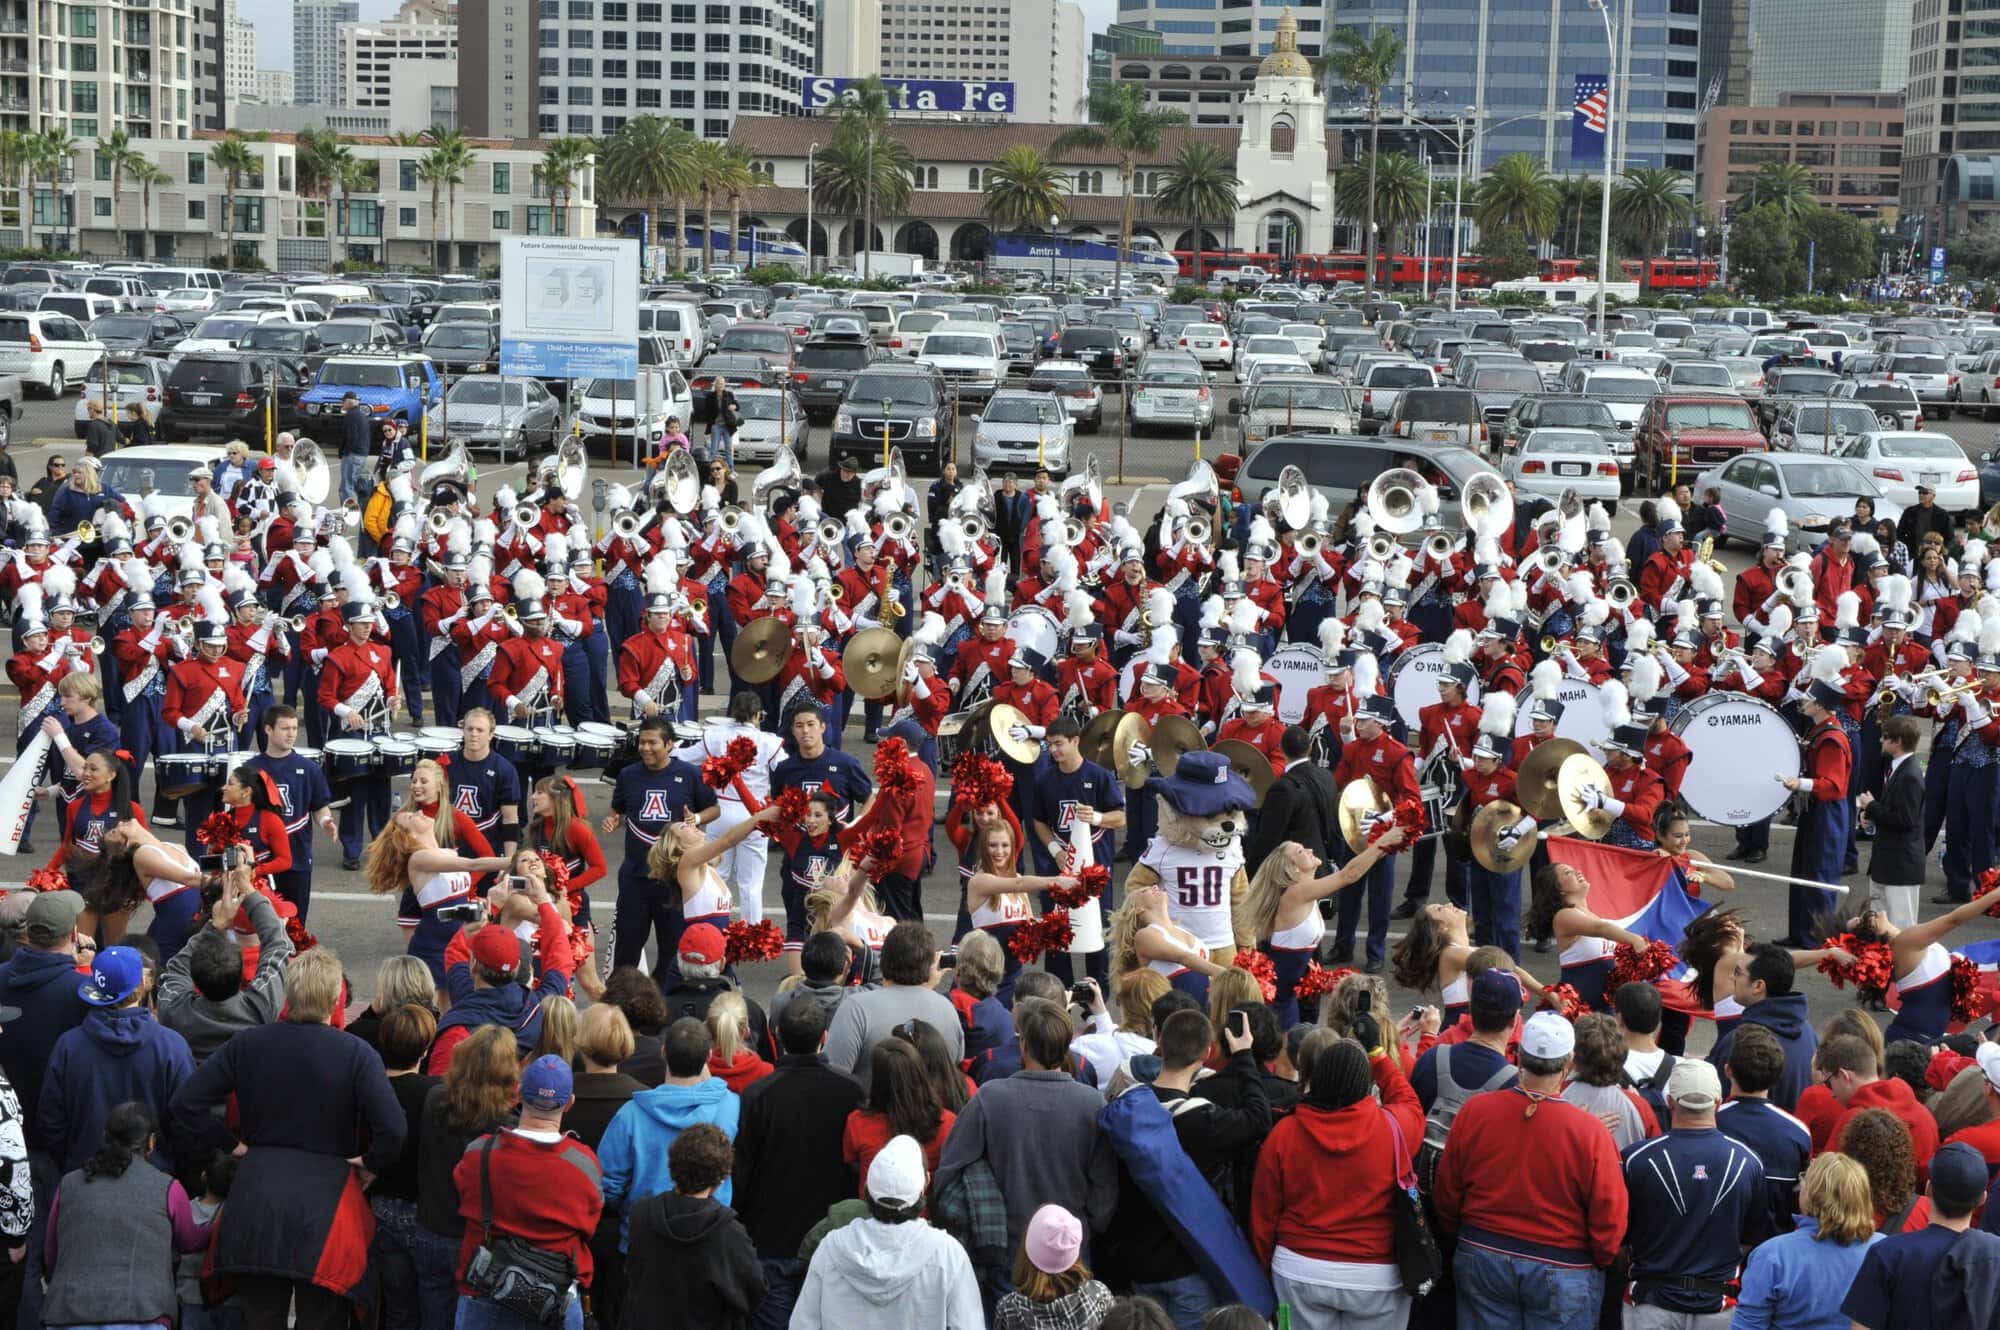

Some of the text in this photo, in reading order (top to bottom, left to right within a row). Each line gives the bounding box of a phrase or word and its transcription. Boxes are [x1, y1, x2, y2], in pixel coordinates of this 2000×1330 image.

[962, 82, 1007, 110] Fe
[541, 242, 578, 250] Commercial
[579, 243, 619, 252] Development
[1933, 247, 1944, 262] 5
[1932, 271, 1942, 281] P
[1282, 660, 1318, 672] YAMAHA
[1558, 689, 1588, 703] MAHA
[1720, 713, 1762, 726] YAMAHA
[454, 784, 482, 818] A
[639, 789, 671, 822] A
[84, 820, 105, 843] A
[1176, 866, 1224, 907] 50
